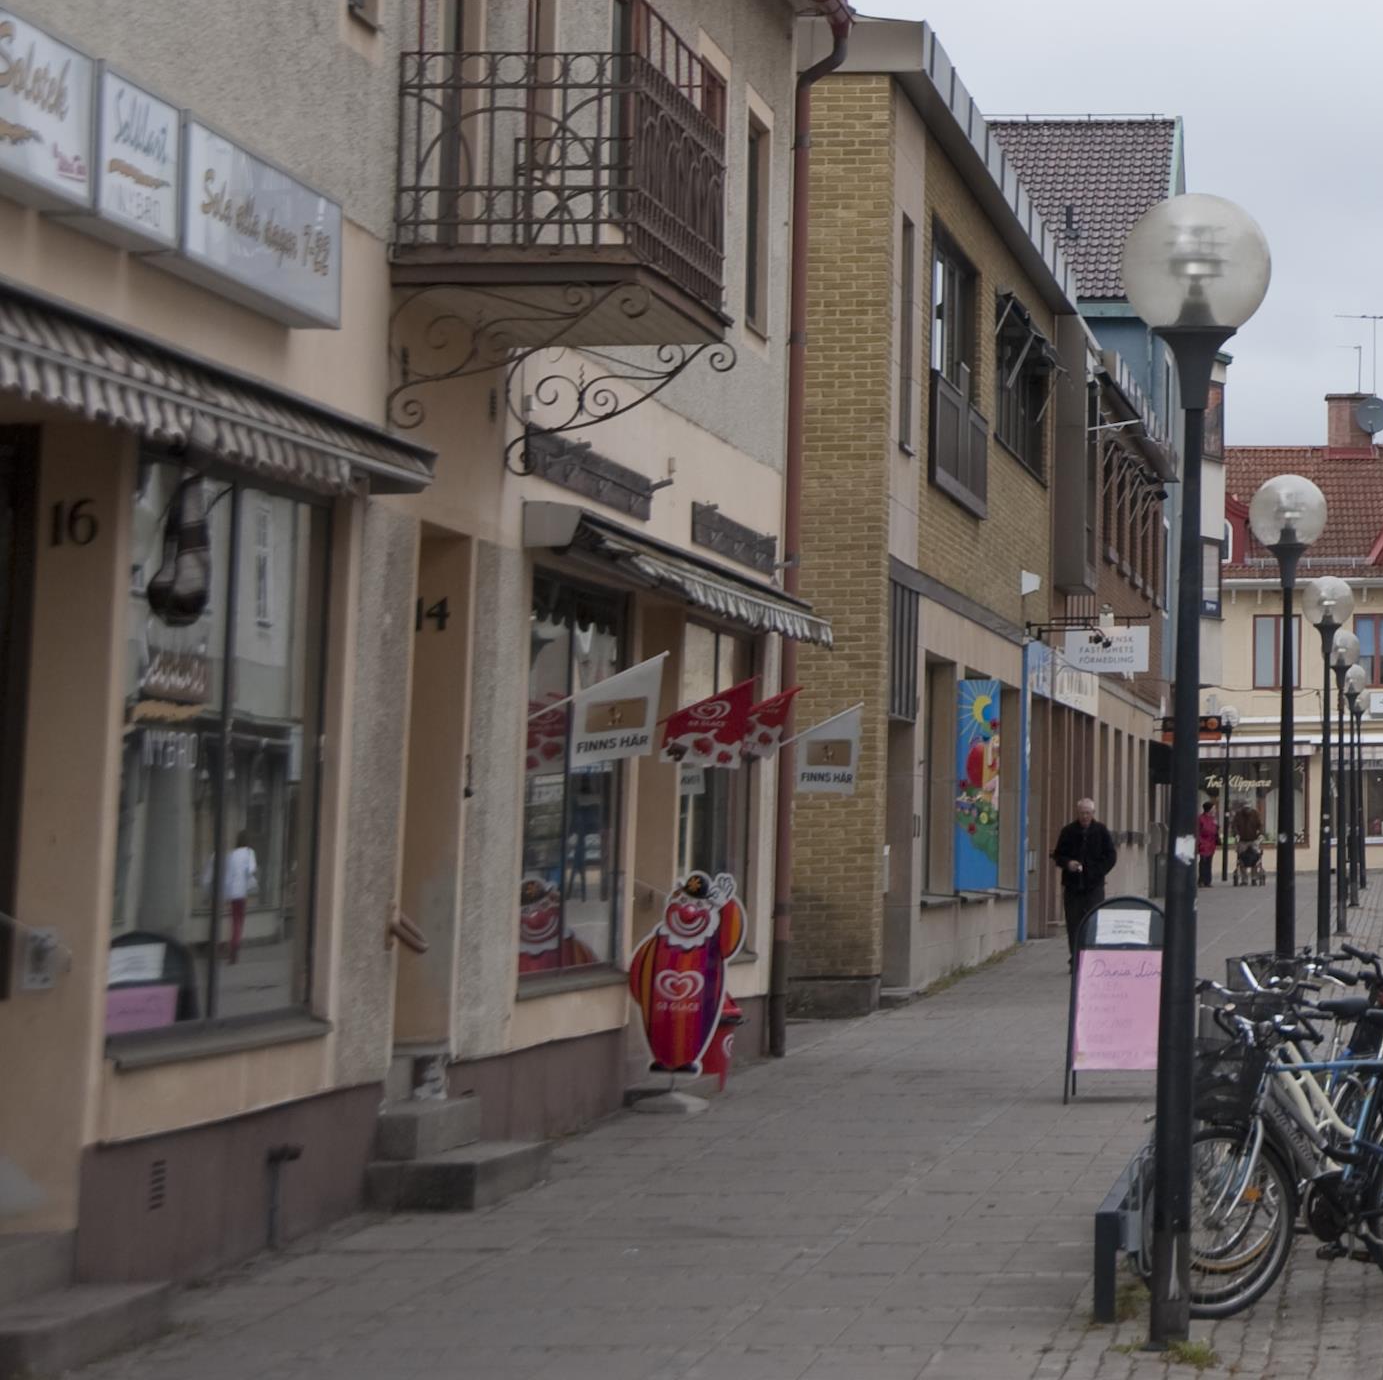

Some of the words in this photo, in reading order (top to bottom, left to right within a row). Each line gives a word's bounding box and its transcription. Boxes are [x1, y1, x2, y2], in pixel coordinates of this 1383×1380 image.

[49, 497, 98, 548] 16
[415, 596, 451, 632] 14
[1078, 655, 1134, 664] FÖRMEDLING
[576, 740, 618, 754] FINNS
[620, 735, 649, 748] HÄR
[800, 771, 832, 782] FINNS
[832, 772, 854, 784] HÄR
